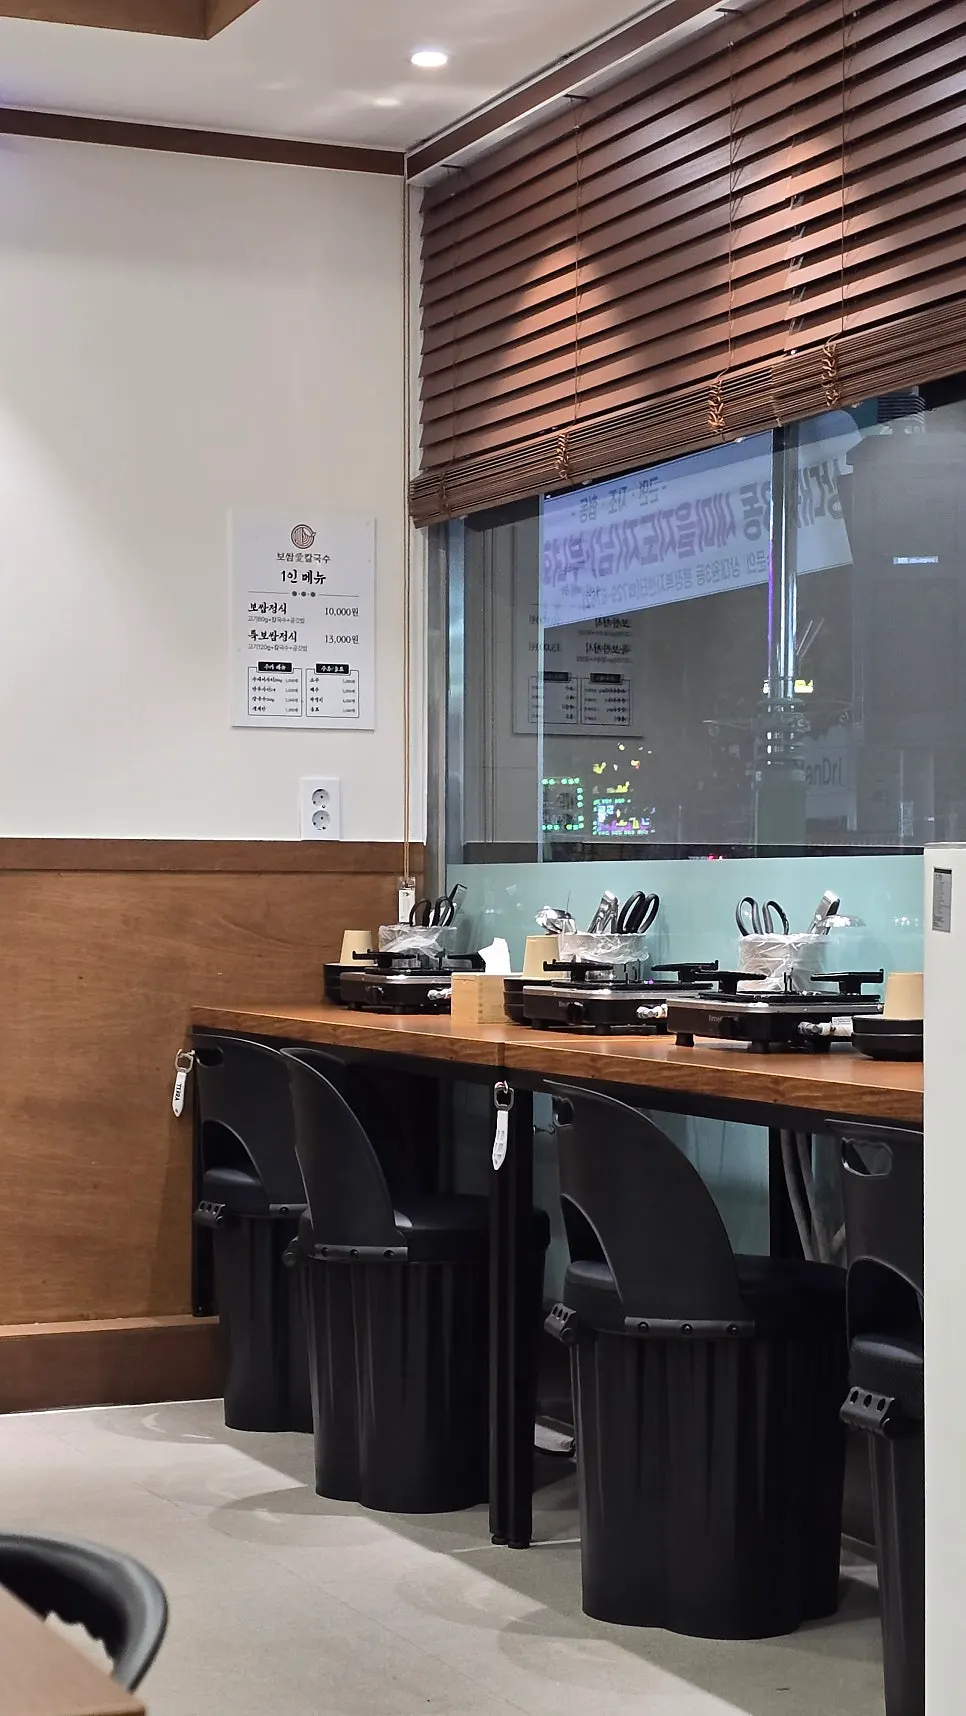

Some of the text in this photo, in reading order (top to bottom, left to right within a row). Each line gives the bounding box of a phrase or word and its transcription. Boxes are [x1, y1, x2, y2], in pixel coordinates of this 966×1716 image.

[276, 552, 331, 563] 보쌈愛칼국수
[281, 569, 326, 585] 1인 메뉴
[248, 602, 359, 617] 보쌈정식 10,000원
[324, 634, 360, 645] 13,000원
